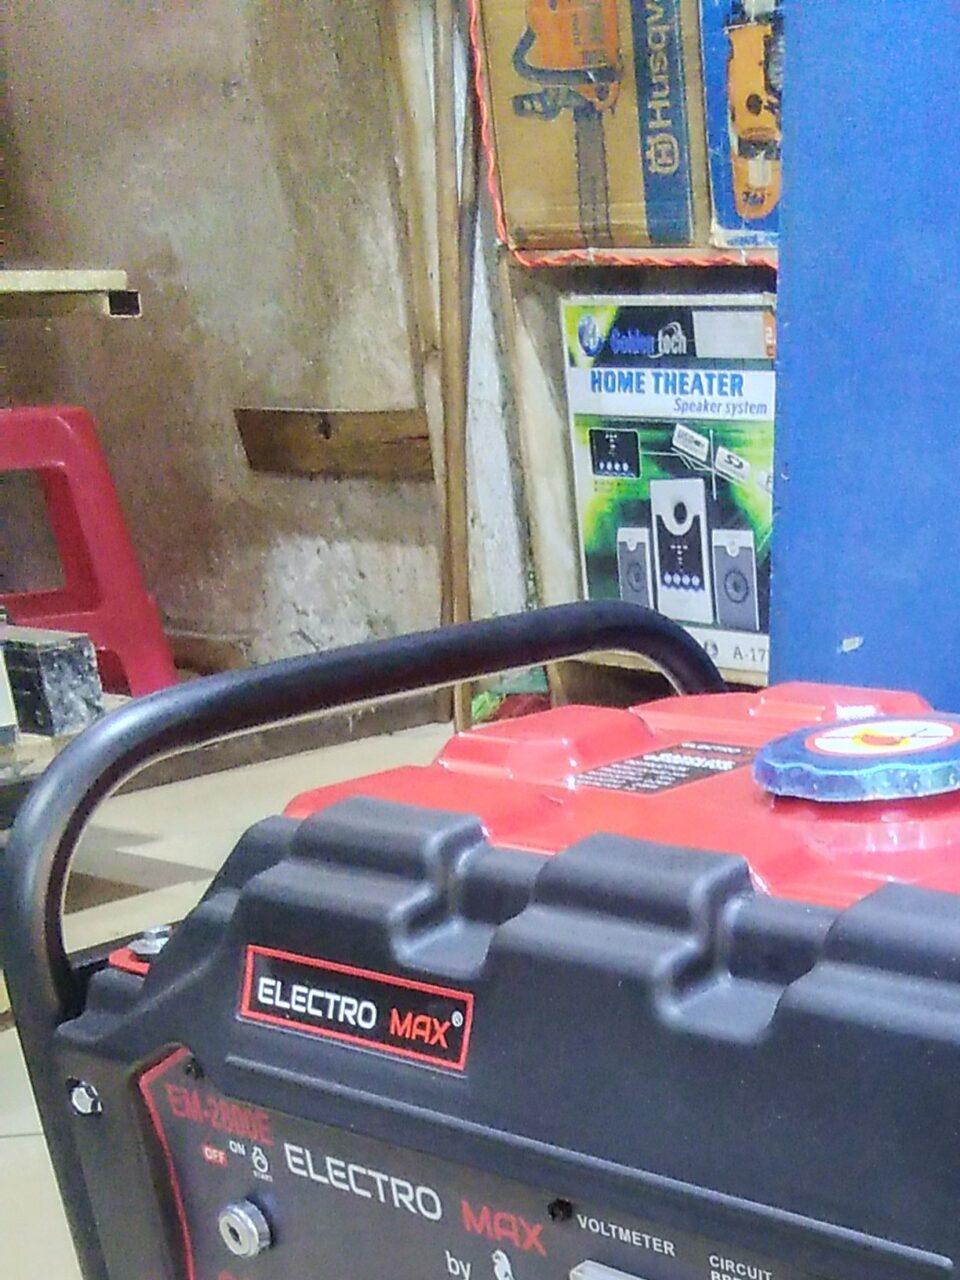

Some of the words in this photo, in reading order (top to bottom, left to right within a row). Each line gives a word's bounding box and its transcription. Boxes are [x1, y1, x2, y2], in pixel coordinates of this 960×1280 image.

[590, 370, 646, 394] HOME
[652, 371, 744, 397] THEATER
[673, 398, 722, 415] Speaker
[725, 400, 768, 416] system
[257, 976, 378, 1030] ELECTRO
[204, 1146, 227, 1165] OFF
[229, 1140, 246, 1156] ON
[283, 1142, 443, 1221] ELECTRO
[460, 1199, 547, 1257] MAX
[576, 1213, 676, 1257] VOLTMETER
